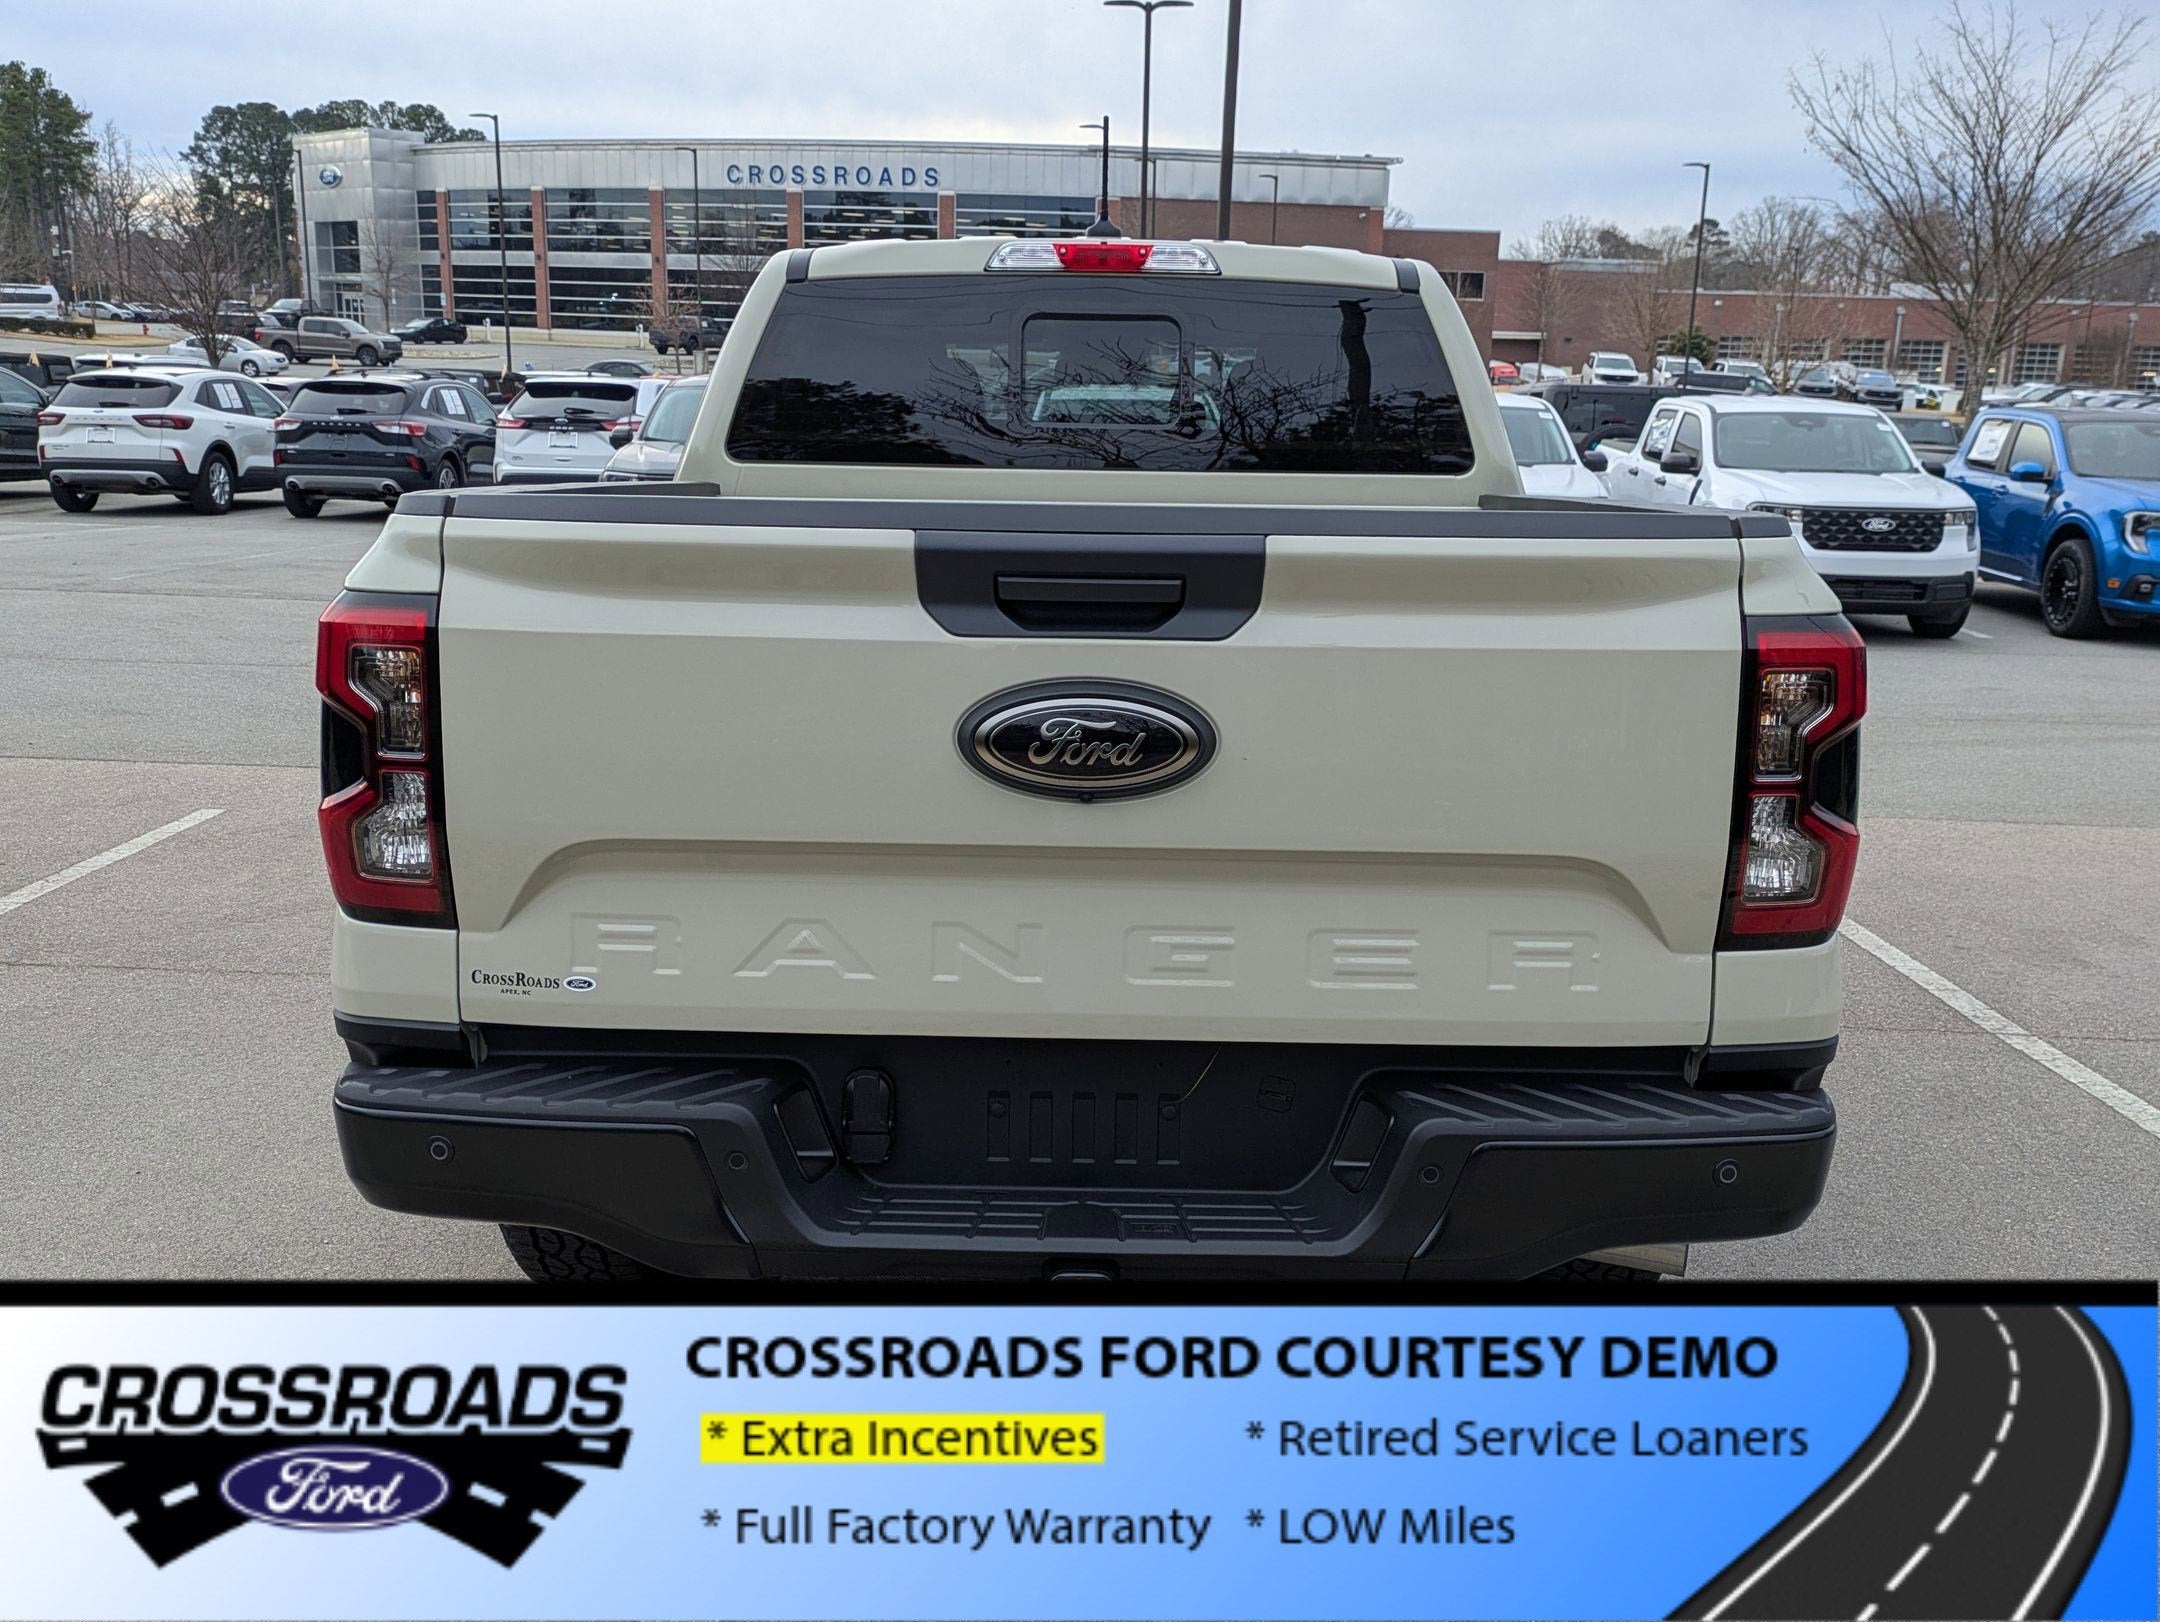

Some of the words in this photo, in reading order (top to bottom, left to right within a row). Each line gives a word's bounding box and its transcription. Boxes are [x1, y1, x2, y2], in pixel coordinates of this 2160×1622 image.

[726, 164, 939, 187] CROSSROADS
[1028, 717, 1147, 766] Ford
[569, 913, 1599, 992] RANGER
[500, 988, 520, 996] APEX,
